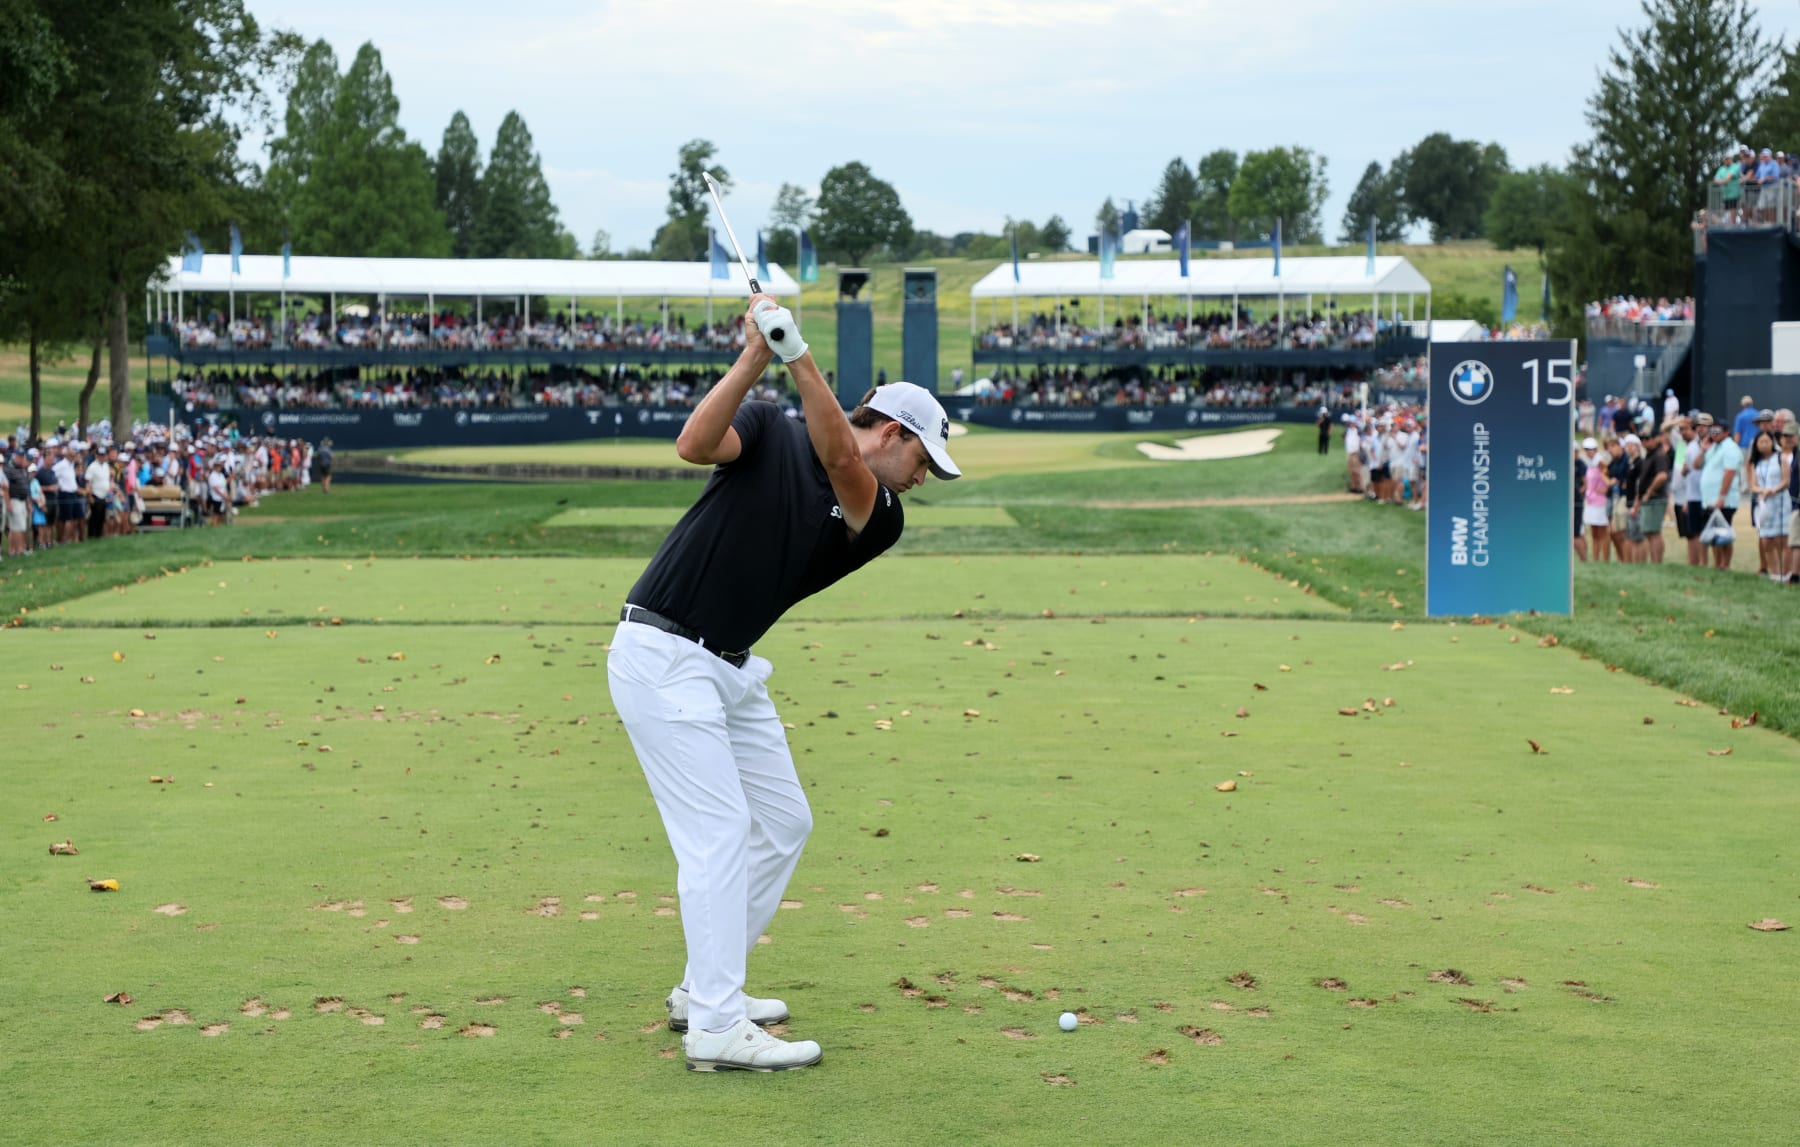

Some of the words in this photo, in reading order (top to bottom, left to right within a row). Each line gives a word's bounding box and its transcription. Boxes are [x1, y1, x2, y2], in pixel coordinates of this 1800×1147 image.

[1522, 358, 1572, 406] 15
[896, 410, 926, 432] Titleist
[1517, 455, 1536, 467] Par
[1537, 455, 1543, 467] 3
[1517, 469, 1536, 481] 234
[1539, 468, 1556, 482] yds
[1472, 422, 1490, 567] CHAMPIONSHIP
[1451, 516, 1468, 566] BMW
